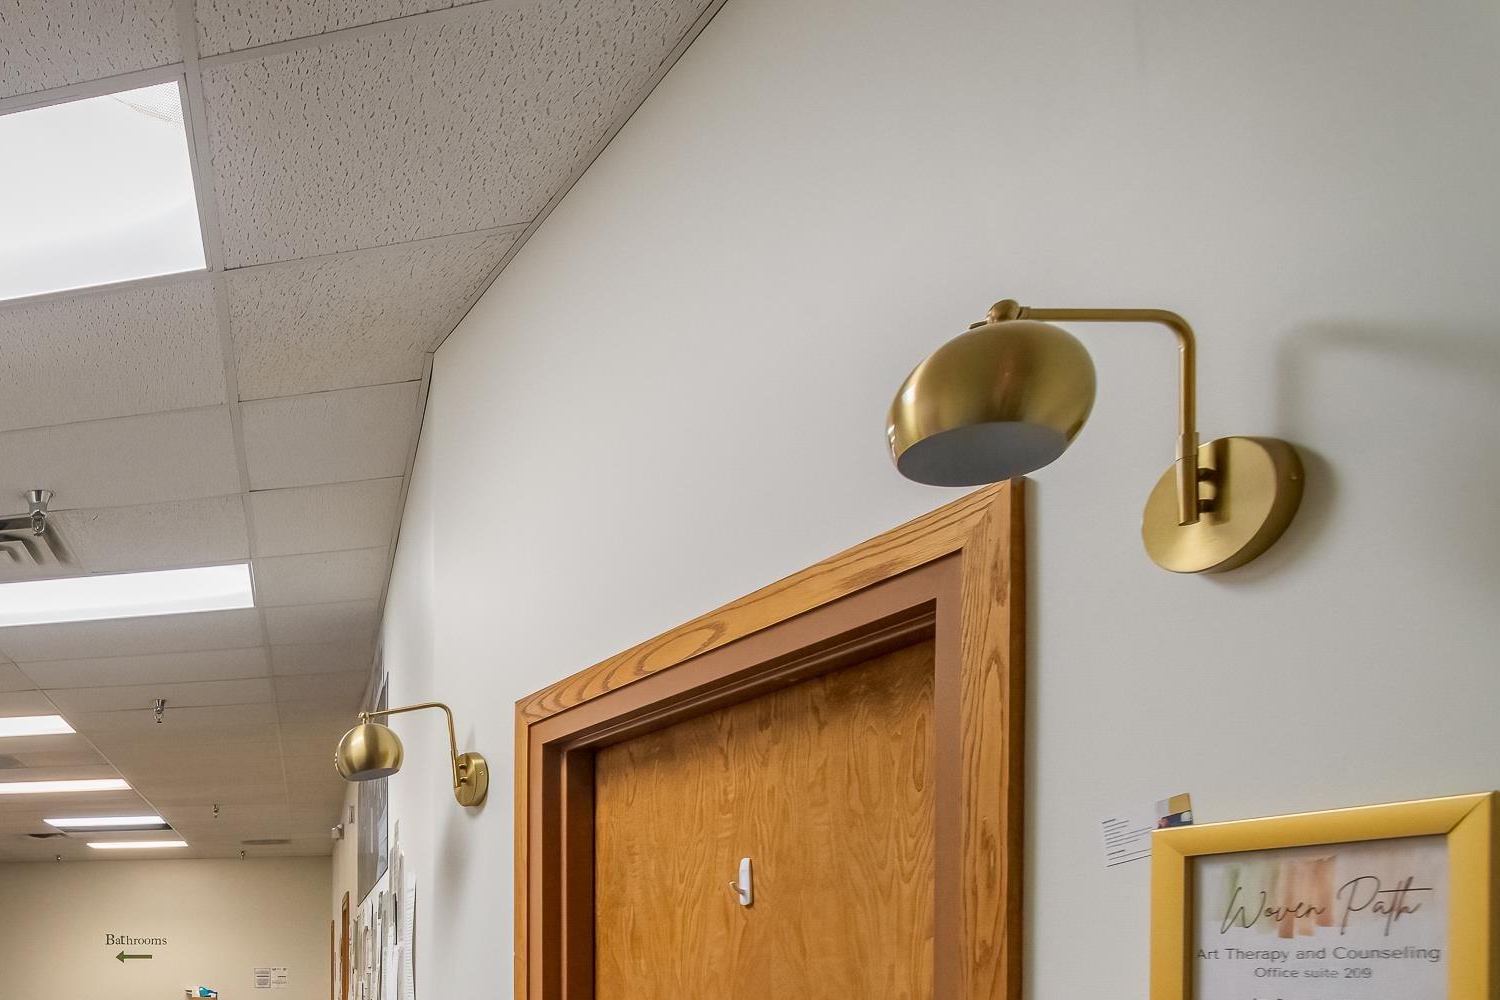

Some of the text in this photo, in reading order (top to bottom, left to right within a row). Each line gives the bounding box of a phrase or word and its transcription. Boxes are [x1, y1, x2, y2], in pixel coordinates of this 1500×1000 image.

[1220, 876, 1434, 937] Woven Path
[104, 933, 168, 946] Bathrooms
[1196, 946, 1442, 963] Art Therapy and Counseling
[1254, 967, 1373, 979] Office suite 209
